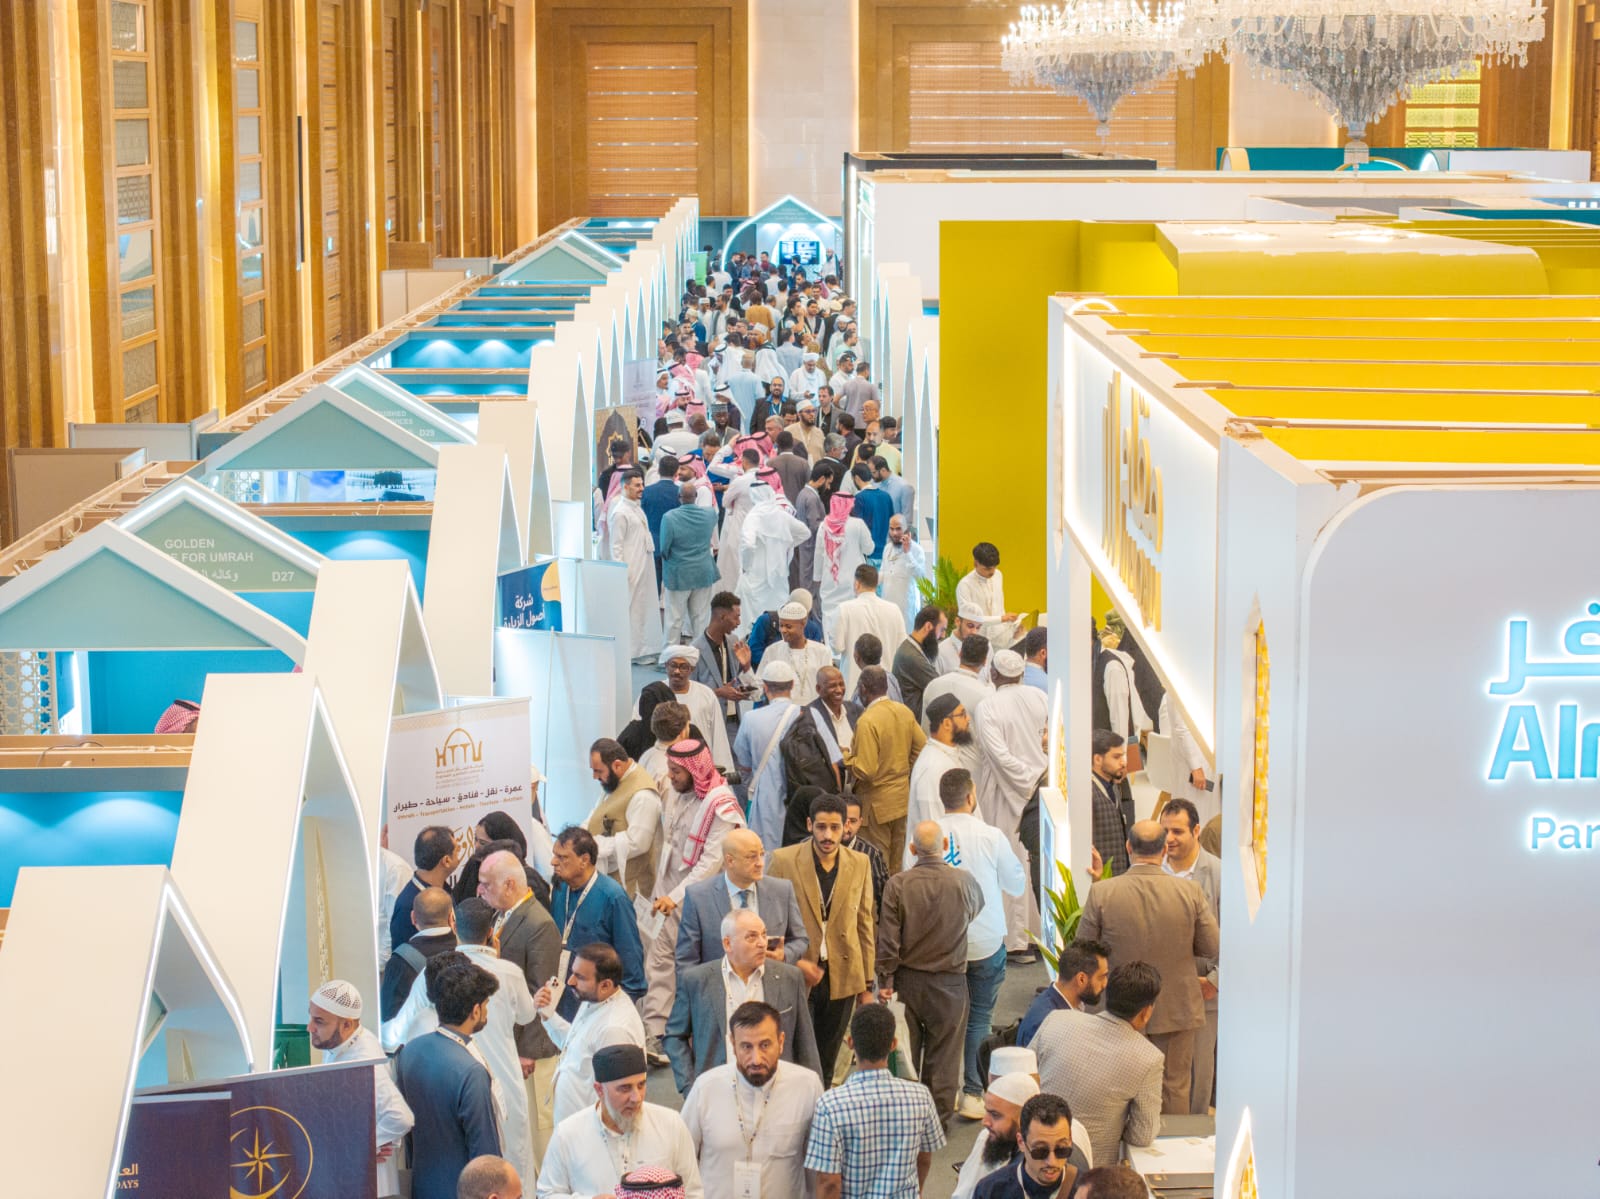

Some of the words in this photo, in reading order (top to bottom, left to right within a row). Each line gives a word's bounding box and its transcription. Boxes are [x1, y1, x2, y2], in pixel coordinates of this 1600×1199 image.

[164, 538, 215, 549] GOLDEN
[181, 552, 206, 562] FOR
[209, 551, 254, 562] UMRAH
[271, 571, 295, 582] D27
[514, 592, 534, 611] شركة
[484, 787, 498, 798] نقل
[504, 784, 523, 795] عمرة
[425, 795, 451, 807] سياحة
[456, 790, 479, 803] فنادق
